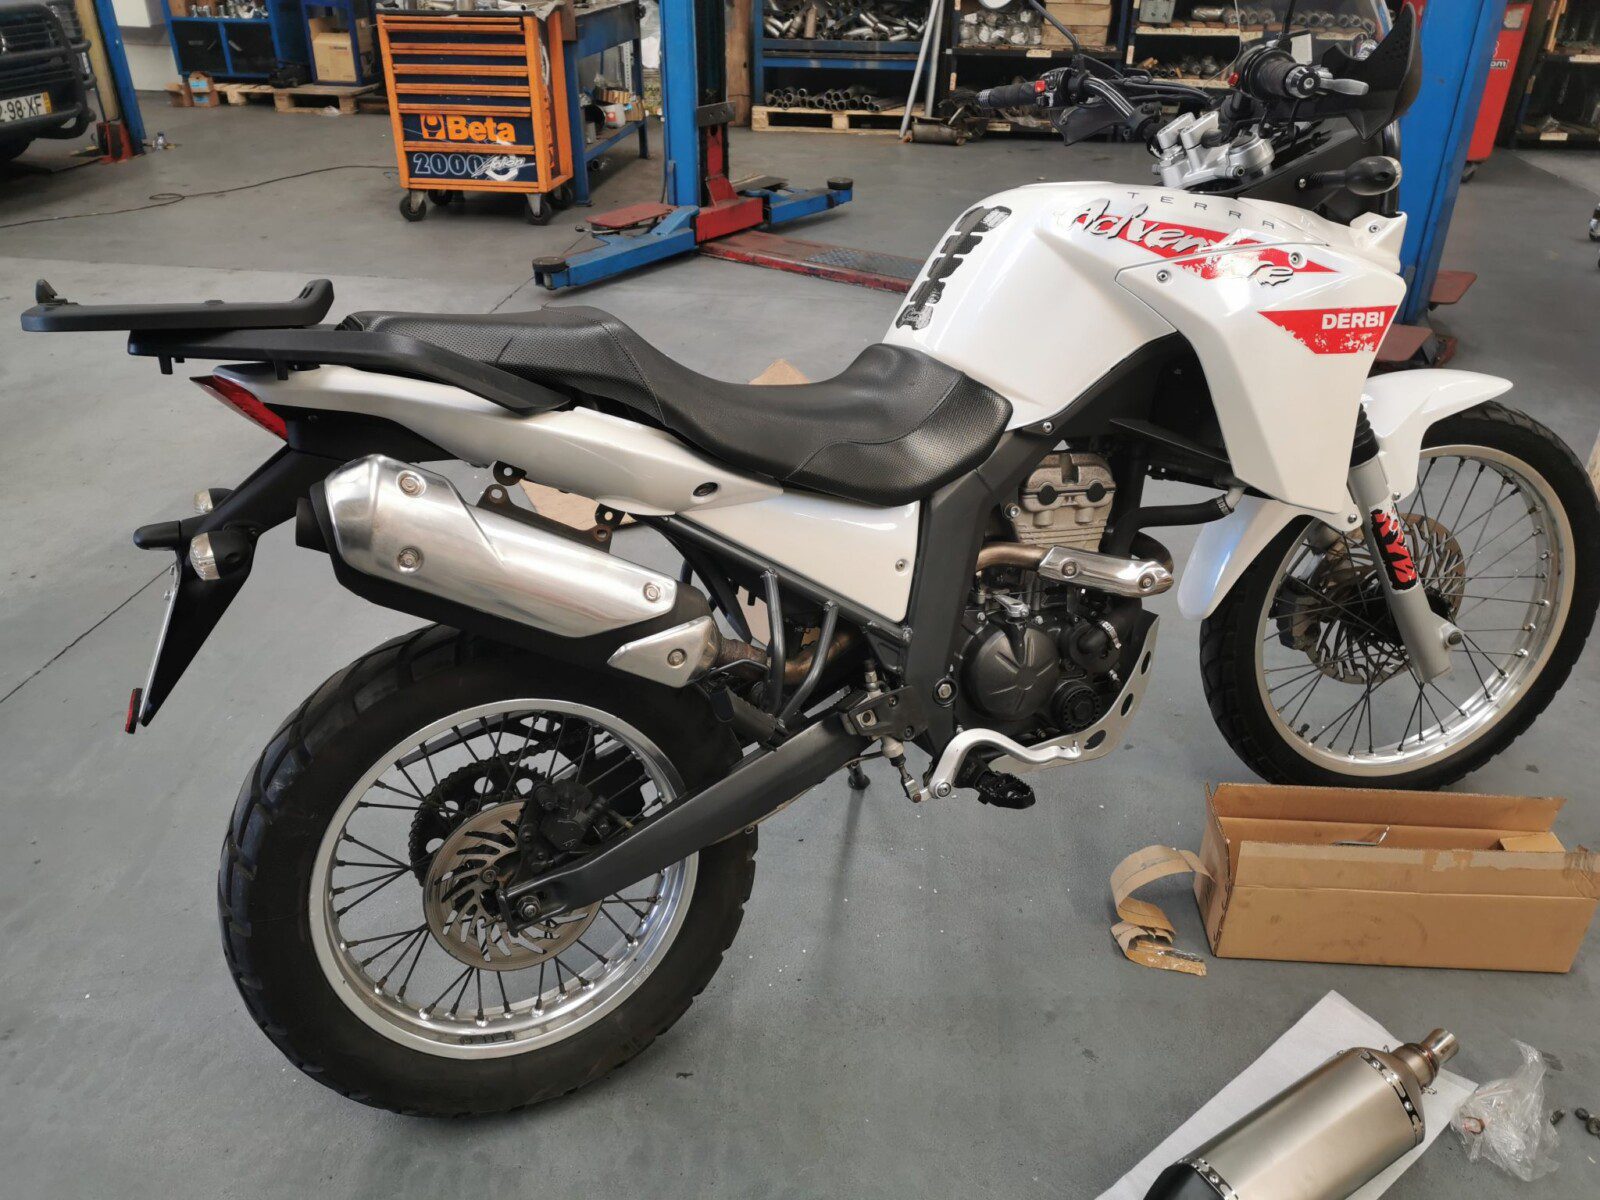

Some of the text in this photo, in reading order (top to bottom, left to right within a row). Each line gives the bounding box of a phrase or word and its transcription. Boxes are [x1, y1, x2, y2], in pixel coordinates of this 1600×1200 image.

[446, 115, 516, 143] Beta
[413, 152, 483, 176] 2000
[1127, 191, 1275, 230] TERRA
[1321, 311, 1386, 330] DERBI
